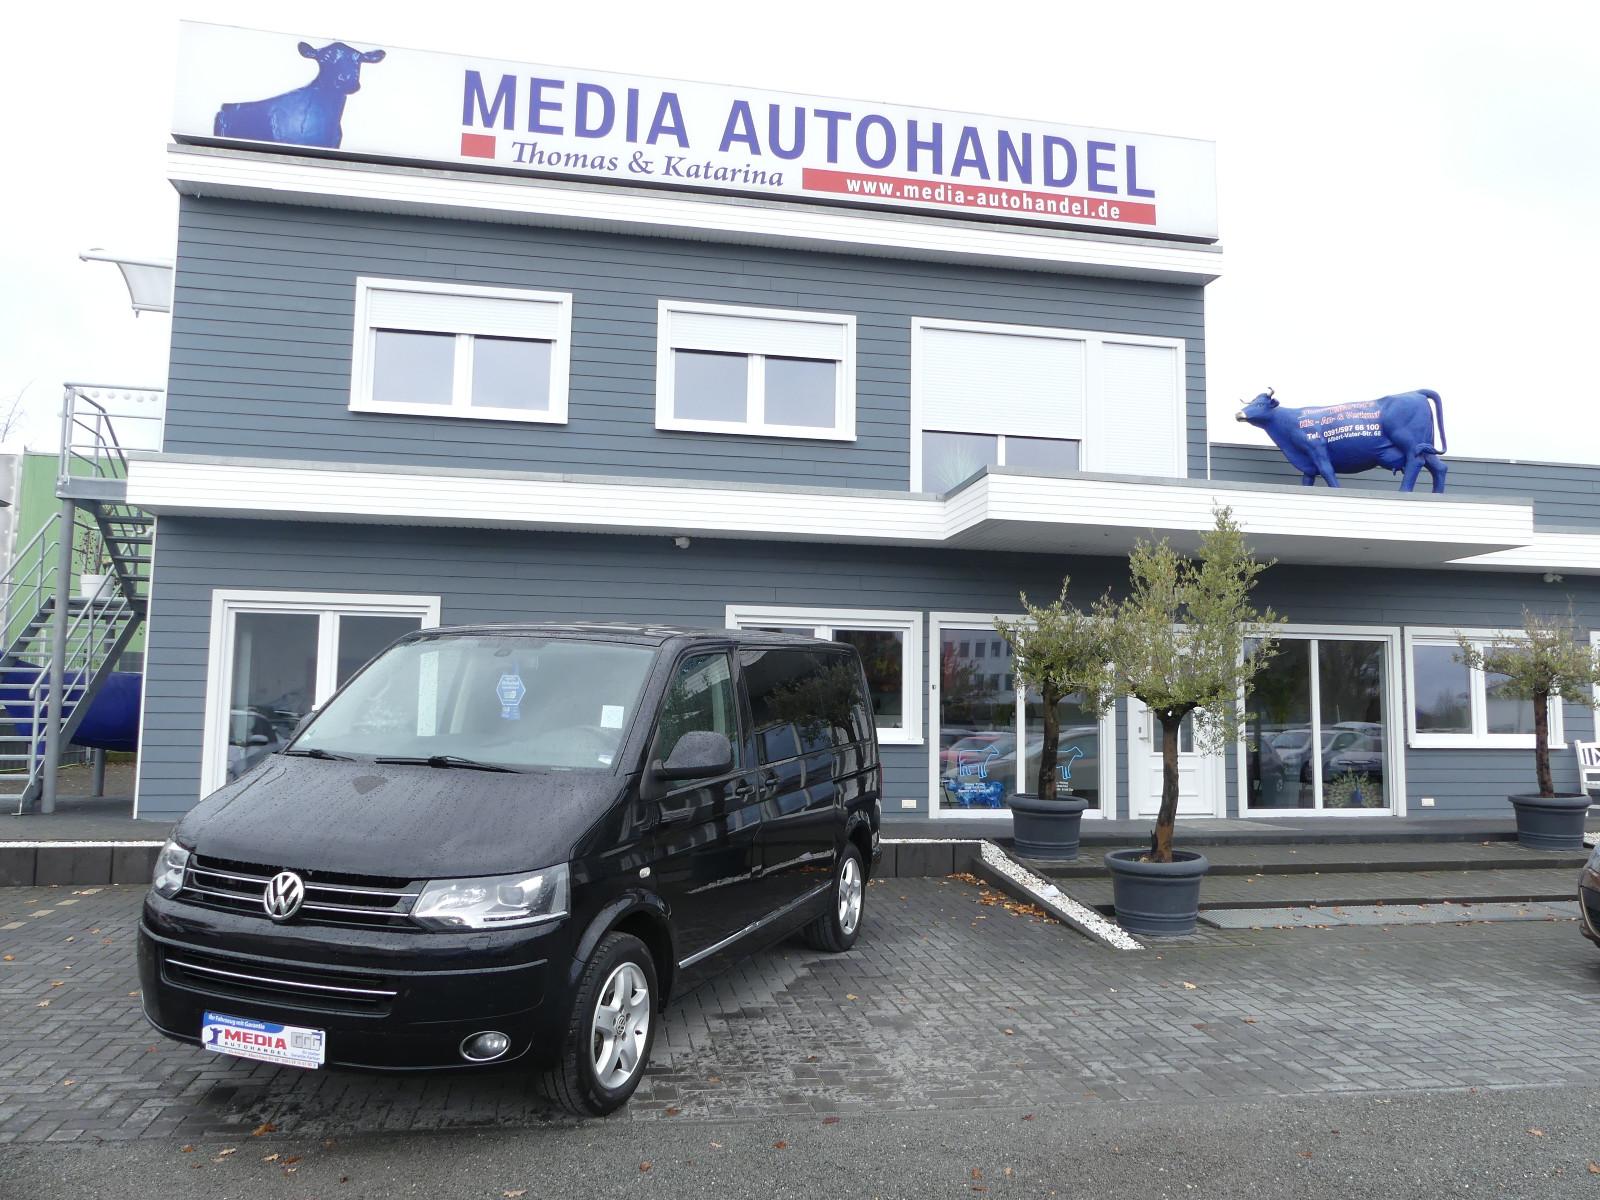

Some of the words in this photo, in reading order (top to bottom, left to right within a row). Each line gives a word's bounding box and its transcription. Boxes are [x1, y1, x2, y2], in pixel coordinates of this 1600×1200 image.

[462, 69, 690, 148] MEDIA
[718, 99, 1156, 199] AUTOHANDEL
[511, 140, 618, 171] Thomas
[628, 150, 654, 175] &
[662, 155, 784, 187] Katarina
[846, 176, 1121, 220] www.media-autohandel.de
[1307, 432, 1320, 440] Tel.
[1366, 423, 1380, 431] 100
[224, 1028, 287, 1050] MEDIA
[224, 1041, 287, 1056] AUTOHANDEL
